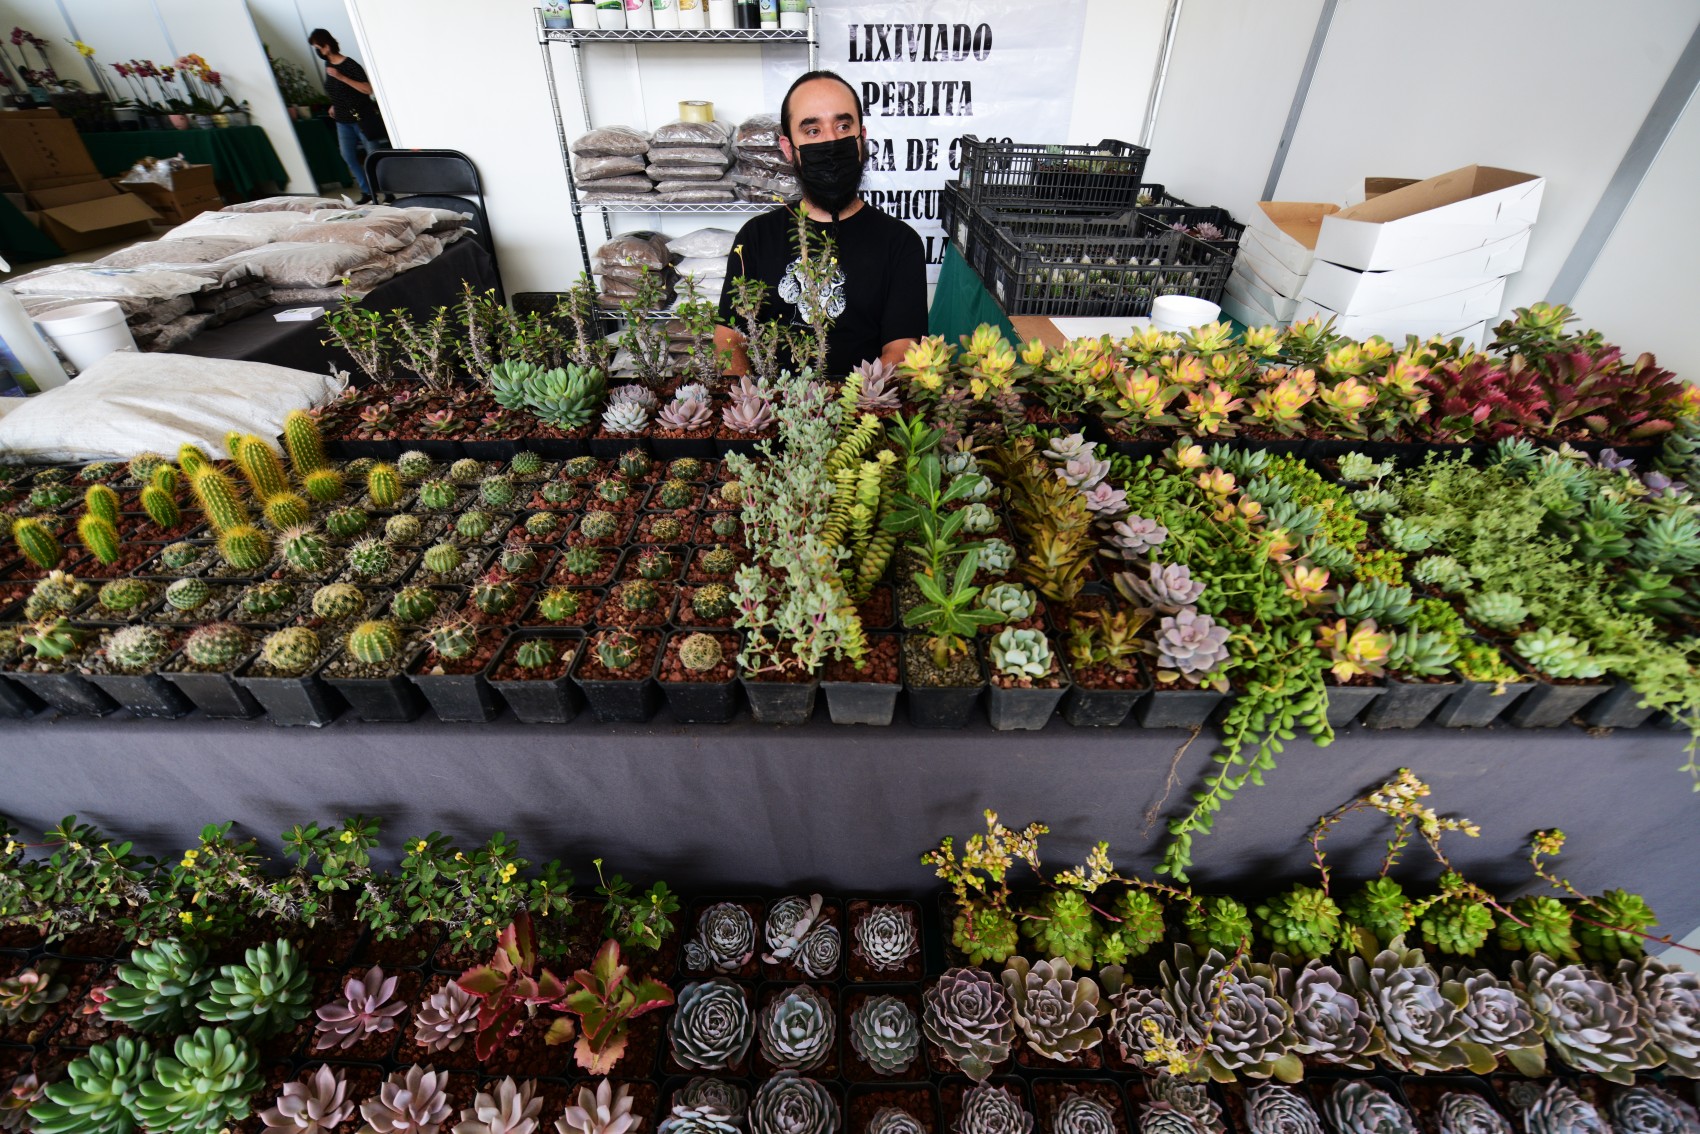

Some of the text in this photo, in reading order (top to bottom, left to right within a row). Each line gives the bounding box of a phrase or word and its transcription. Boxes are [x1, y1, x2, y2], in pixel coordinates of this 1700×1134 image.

[848, 23, 993, 62] LIXIVIADO
[861, 81, 973, 117] PERLITA
[905, 138, 939, 171] DE
